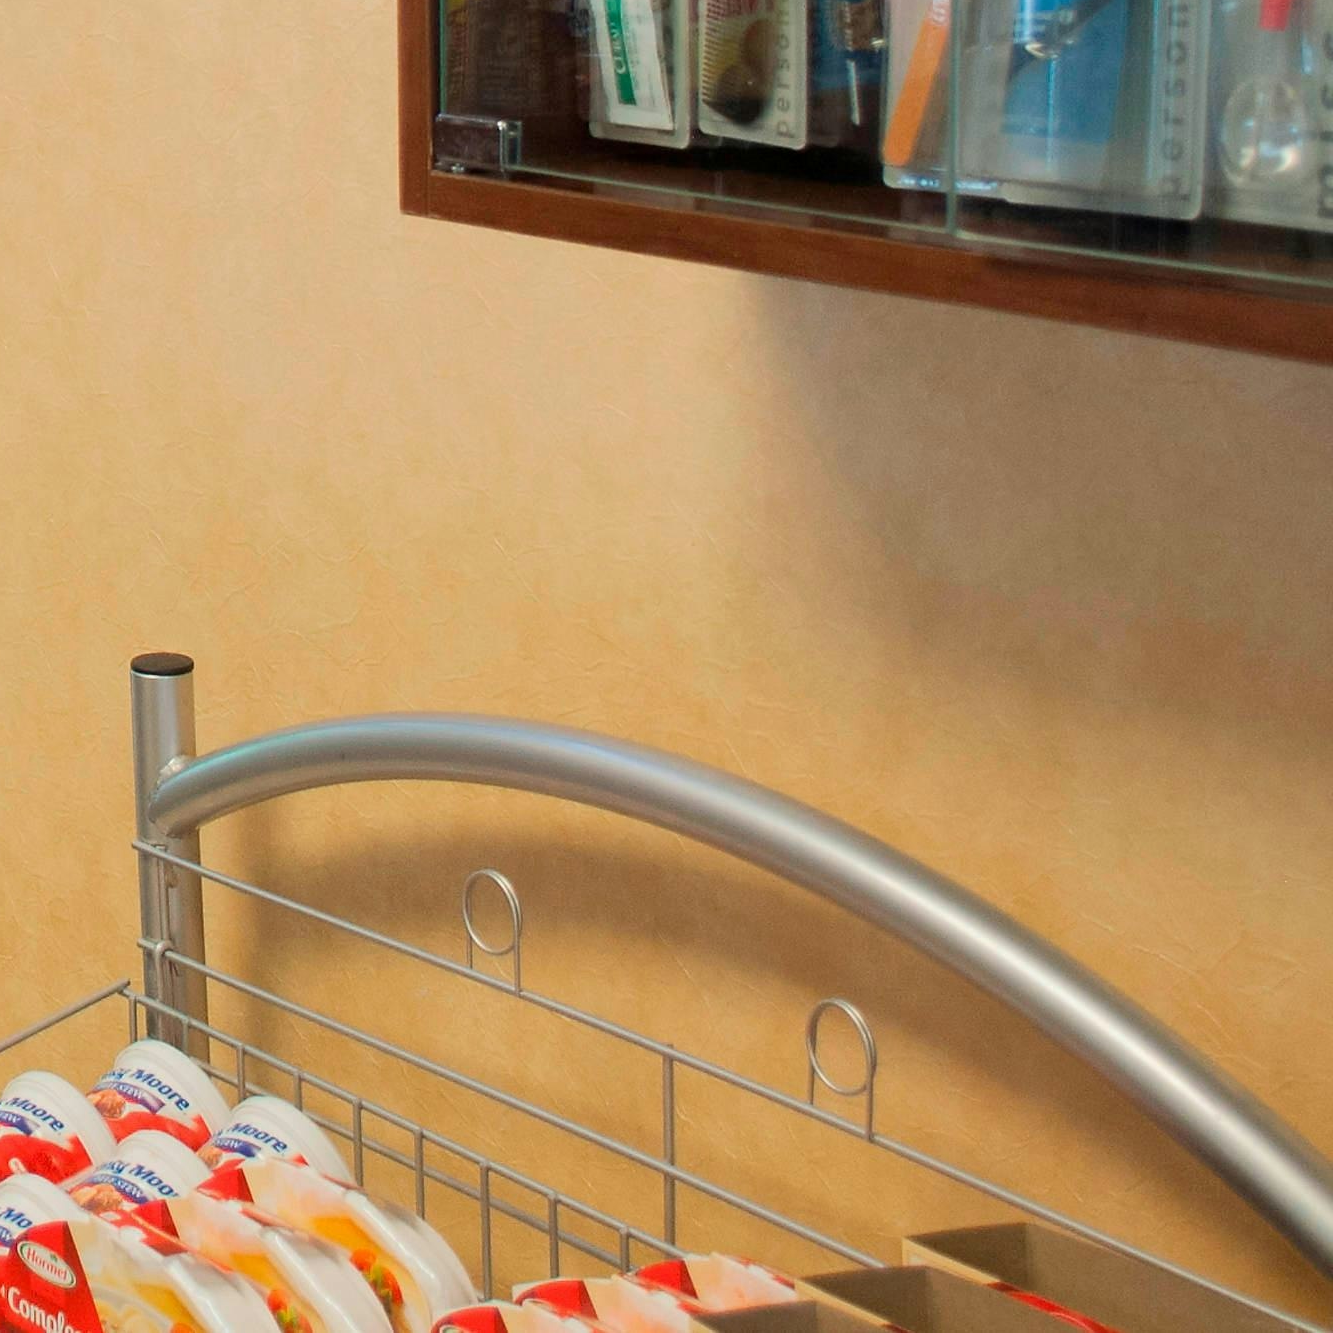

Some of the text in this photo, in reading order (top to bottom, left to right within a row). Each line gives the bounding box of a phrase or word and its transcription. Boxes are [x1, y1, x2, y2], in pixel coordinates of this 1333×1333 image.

[131, 1068, 191, 1112] Moore
[5, 1096, 65, 1133] Moore
[228, 1121, 289, 1154] Moore
[26, 1247, 69, 1283] Hormel
